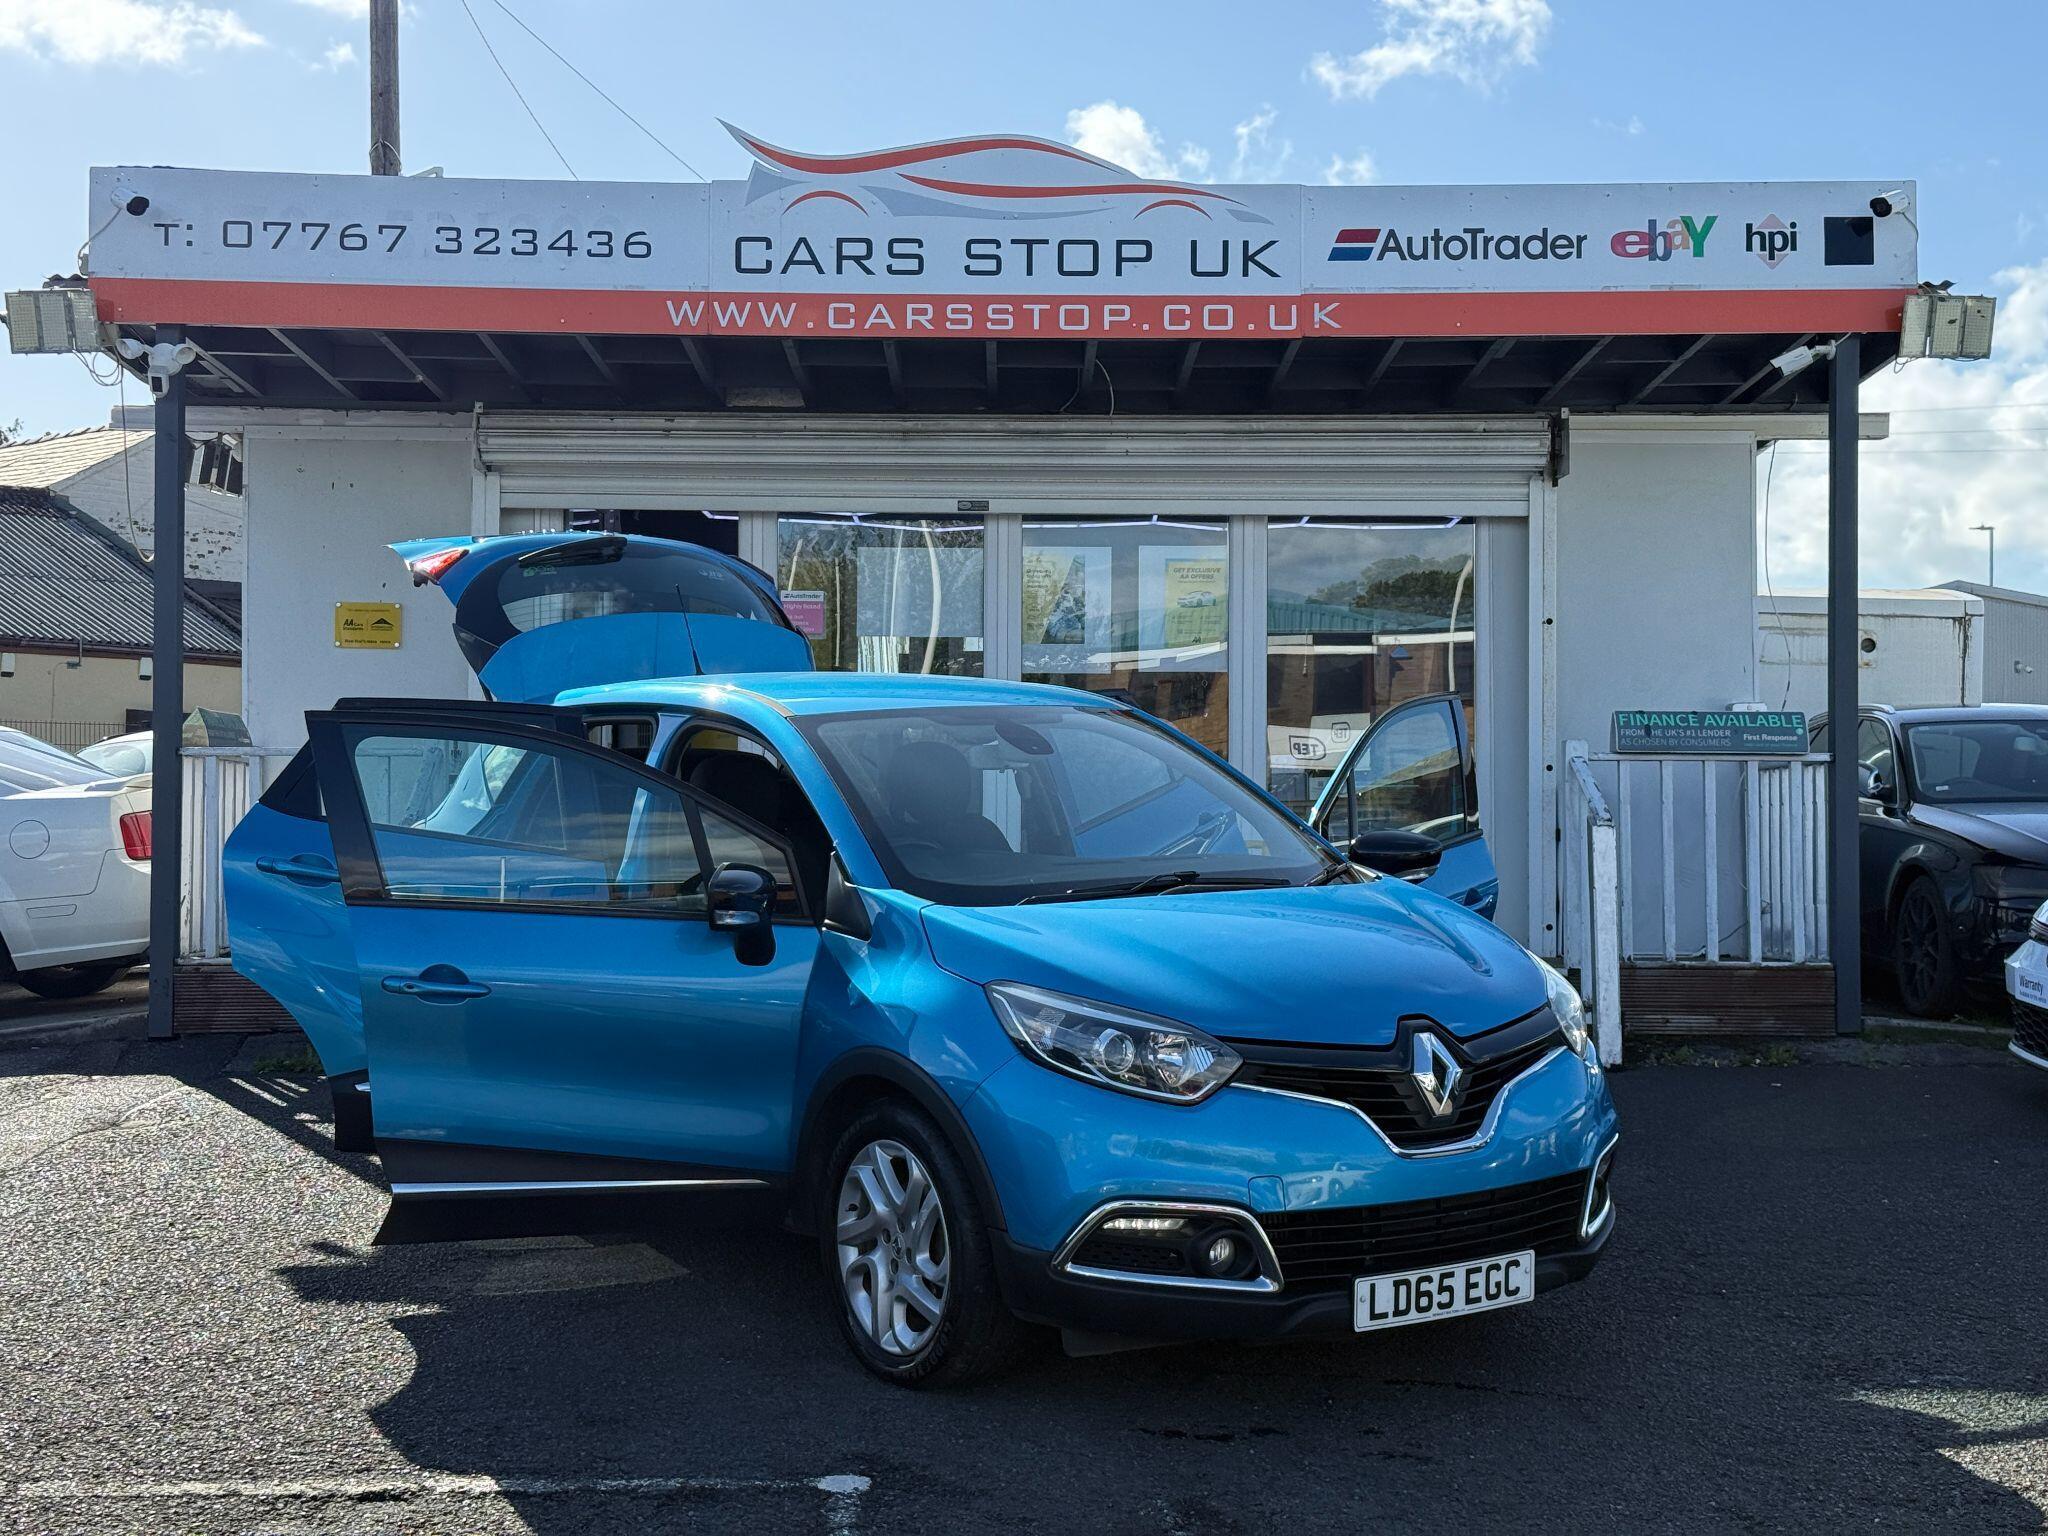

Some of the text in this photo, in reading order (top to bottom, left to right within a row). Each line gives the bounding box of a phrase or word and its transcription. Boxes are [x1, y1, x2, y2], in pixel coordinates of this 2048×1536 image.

[154, 219, 654, 259] T: 07767 323436
[1376, 227, 1588, 262] AutoTrader
[1745, 221, 1798, 255] hpi
[734, 235, 1282, 279] CARS STOP UK
[665, 299, 1342, 331] WWW.CARSSTOP.CO.UK
[1619, 713, 1804, 728] FINANCE AVAILABLE
[1620, 728, 1645, 736] FROM
[1645, 728, 1663, 736] HE
[1665, 728, 1685, 736] UK'S
[1698, 729, 1732, 737] LENDER
[1620, 737, 1732, 747] AS CHOSEN BY CONSUMERS
[1743, 733, 1798, 742] First Response
[2019, 974, 2044, 996] Warranty
[1369, 1259, 1521, 1321] LD65 EGC
